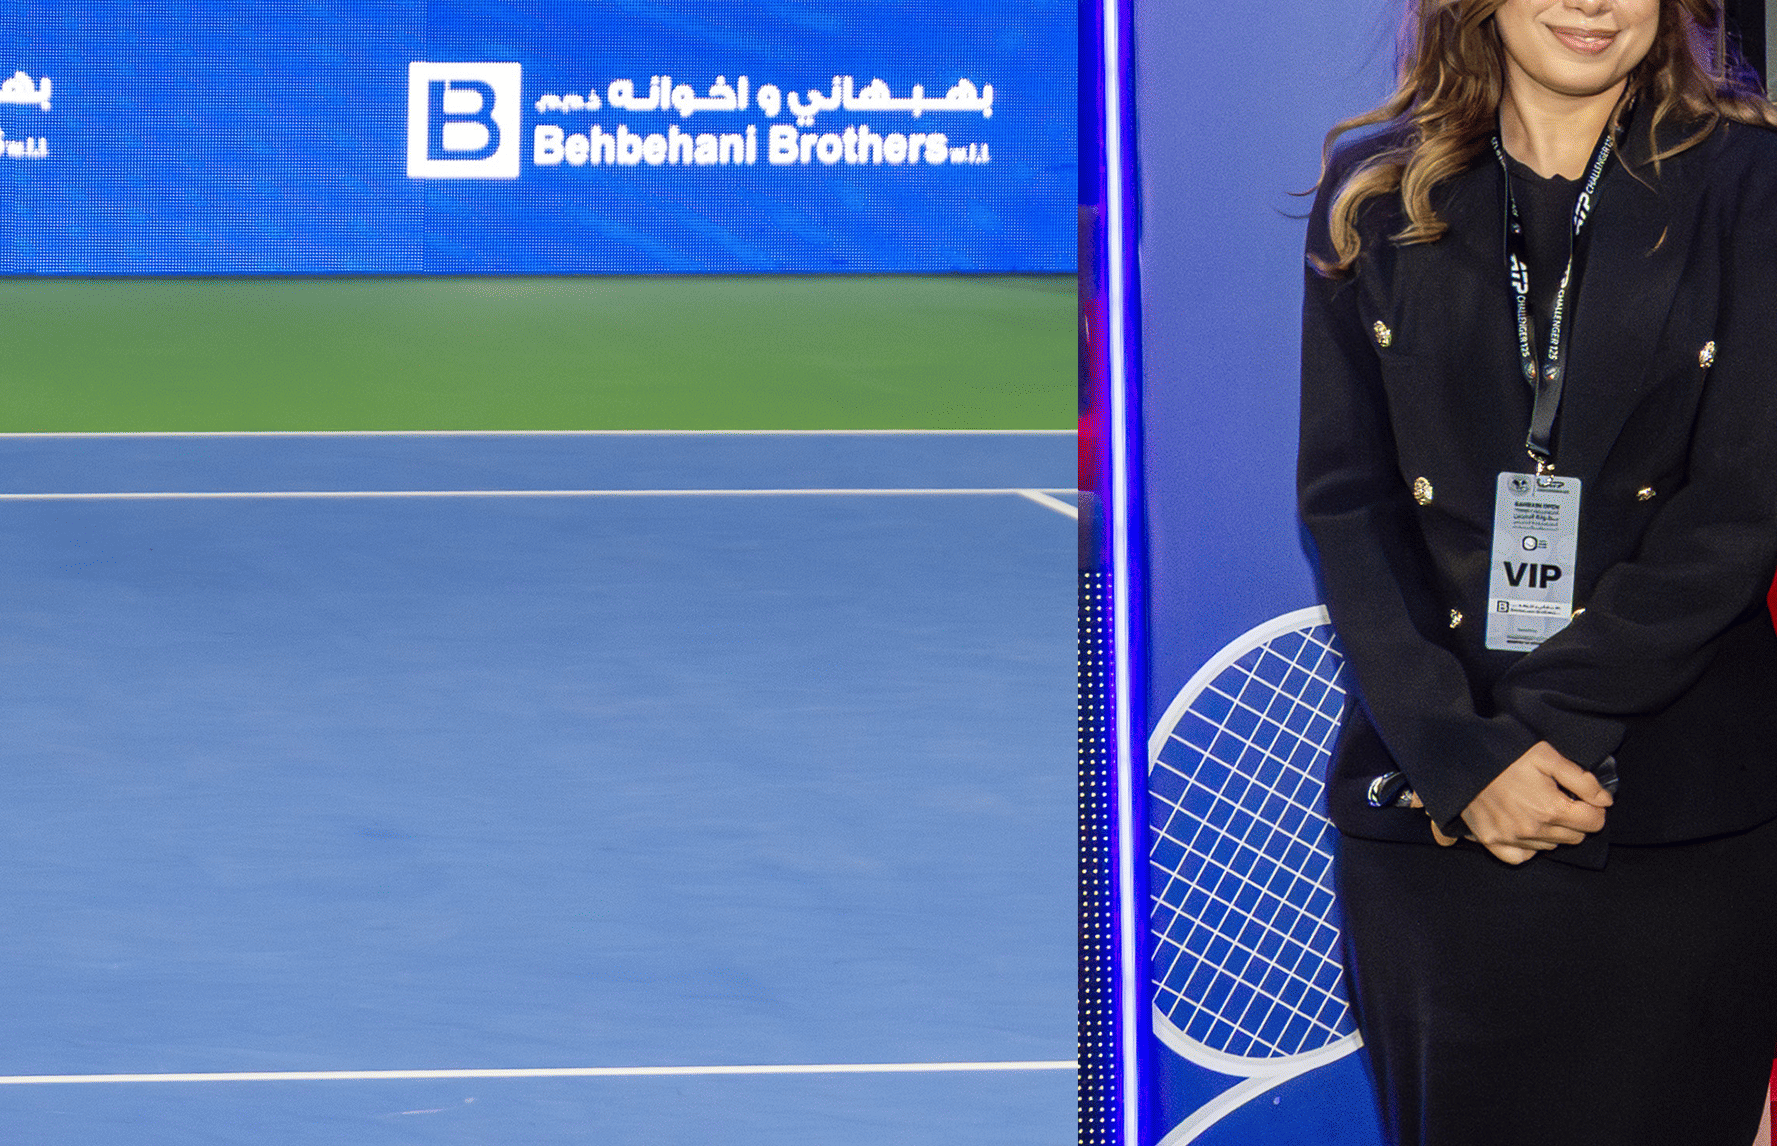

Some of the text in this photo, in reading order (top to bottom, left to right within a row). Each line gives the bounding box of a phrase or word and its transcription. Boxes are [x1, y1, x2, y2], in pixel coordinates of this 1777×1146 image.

[533, 124, 757, 166] Behbehani
[769, 124, 948, 164] Brothers
[1510, 253, 1529, 294] ATP
[1548, 289, 1565, 361] CHALLENGER 125
[1503, 561, 1562, 589] VIP
